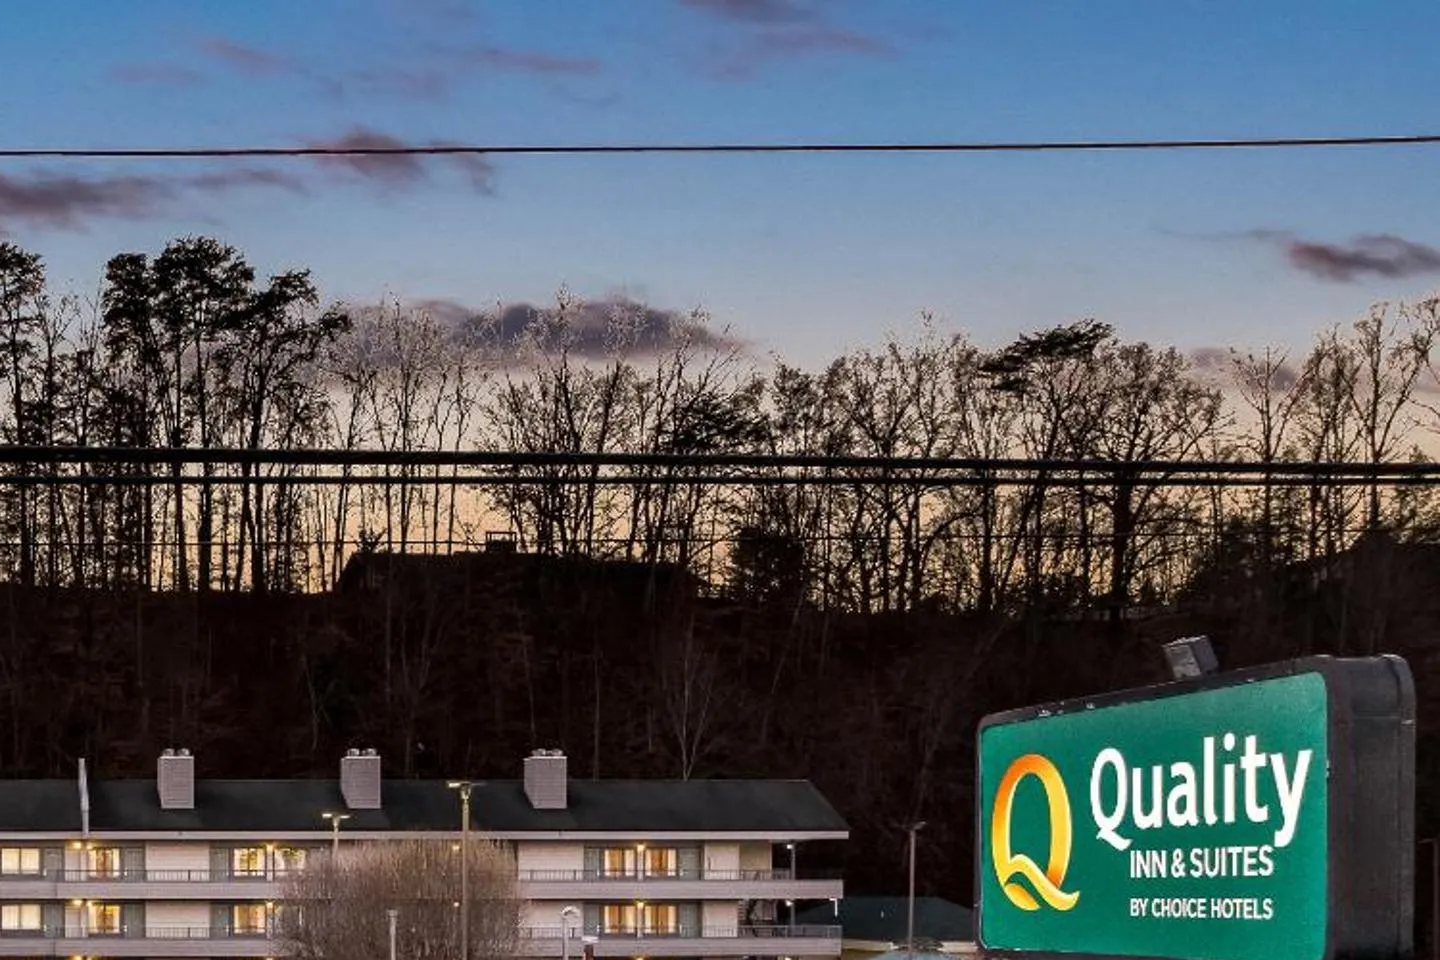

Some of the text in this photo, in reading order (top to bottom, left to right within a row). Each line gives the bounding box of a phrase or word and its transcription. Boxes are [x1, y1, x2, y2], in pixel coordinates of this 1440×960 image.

[1090, 732, 1313, 851] Quality
[991, 753, 1080, 911] Q
[1130, 844, 1274, 878] INN & SUITES
[1130, 898, 1274, 920] BY CHOICE HOTELS
